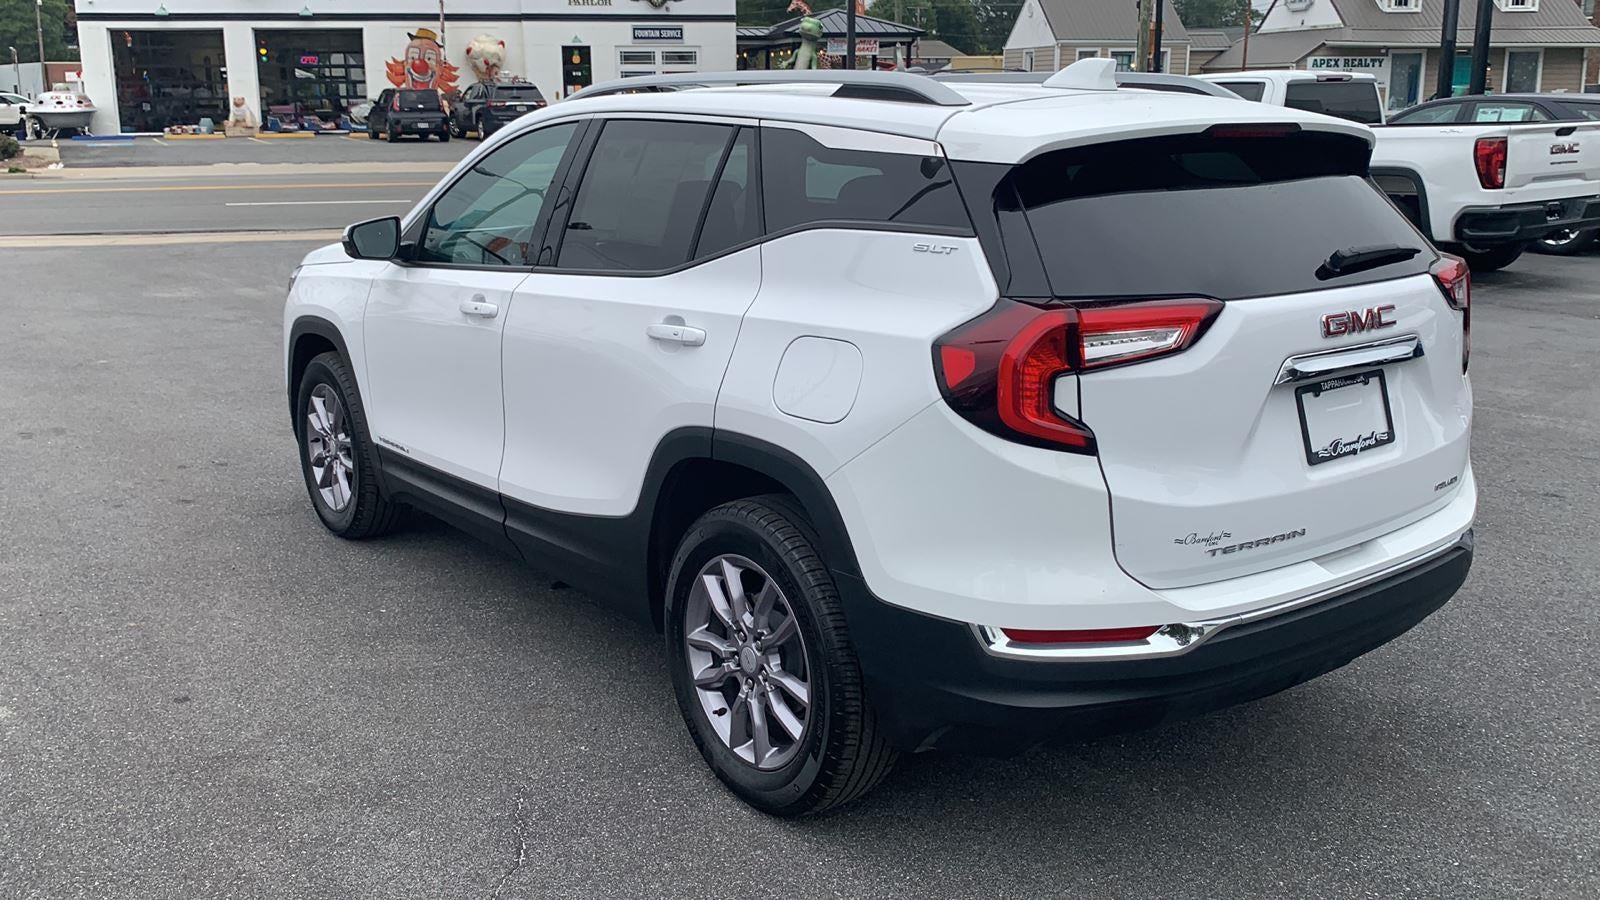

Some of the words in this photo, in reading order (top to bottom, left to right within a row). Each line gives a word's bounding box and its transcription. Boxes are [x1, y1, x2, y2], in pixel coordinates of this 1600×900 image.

[634, 29, 660, 38] FOUNTAIN
[660, 29, 682, 38] SERVICE
[1311, 58, 1340, 68] APEX
[1343, 58, 1385, 68] REALTY
[1550, 143, 1580, 155] GMC
[912, 242, 959, 255] SLT
[1320, 304, 1398, 338] GMC
[1328, 431, 1377, 456] Bareford
[1205, 528, 1306, 557] TERRAIN
